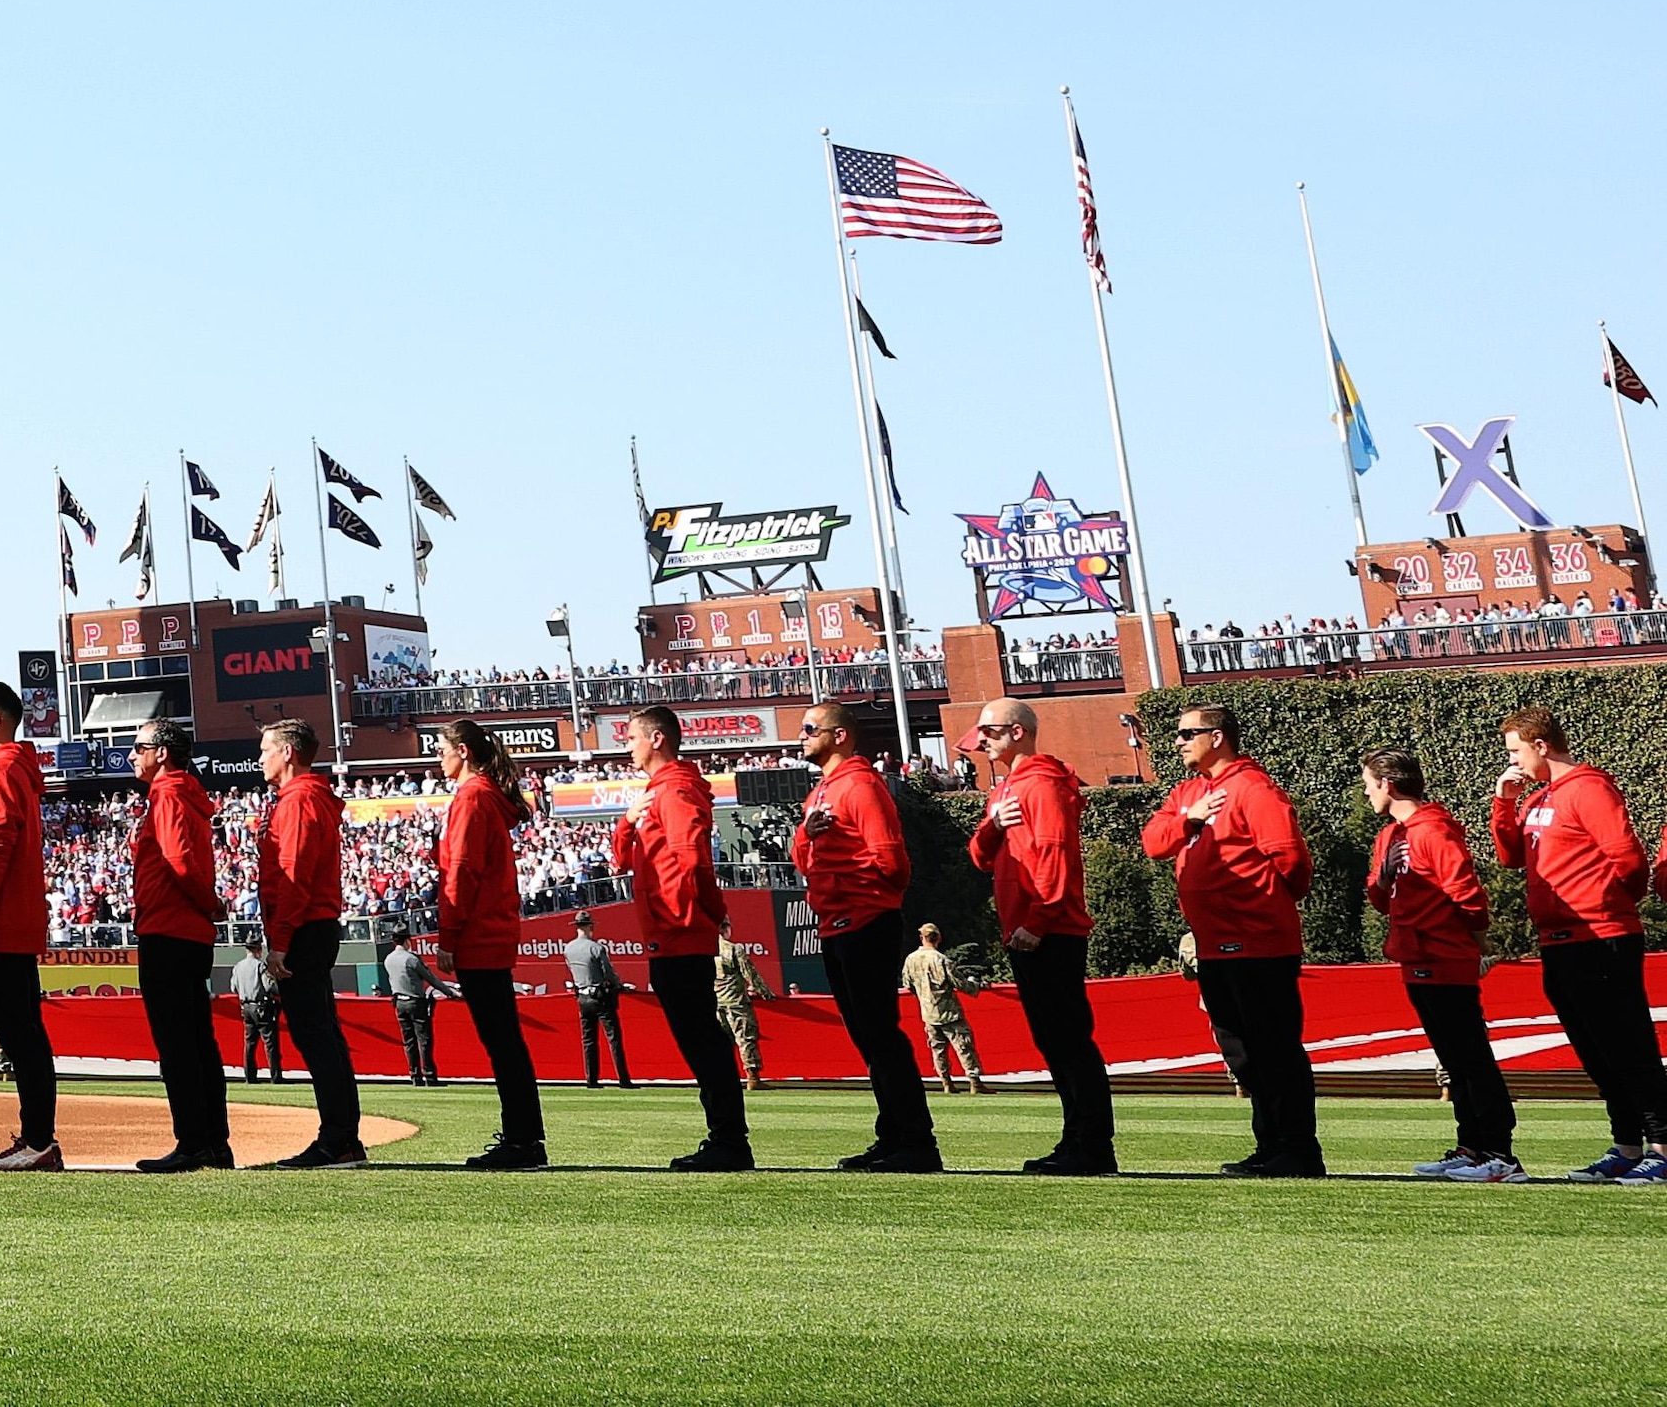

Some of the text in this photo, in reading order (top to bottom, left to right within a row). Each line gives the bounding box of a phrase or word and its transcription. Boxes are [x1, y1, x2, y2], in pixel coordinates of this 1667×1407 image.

[652, 510, 682, 532] PJ
[663, 506, 827, 552] Fitzpatrick
[788, 543, 816, 554] BATHS
[963, 526, 1127, 566] ALL STAR GAME
[1549, 542, 1587, 573] 36
[1394, 555, 1429, 584] 20
[1441, 551, 1479, 582] 32
[1493, 547, 1533, 578] 34
[1495, 575, 1537, 588] HALLADAY
[1553, 571, 1591, 584] ROBERTS
[161, 616, 180, 641] P
[675, 615, 696, 640] P
[817, 603, 843, 630] 15
[84, 623, 102, 648] P
[122, 619, 140, 645] P
[224, 648, 312, 676] GIANT
[680, 715, 761, 733] LUKE'S
[212, 758, 263, 774] Fanatics
[39, 951, 130, 966] PLUNDH
[598, 938, 644, 955] State
